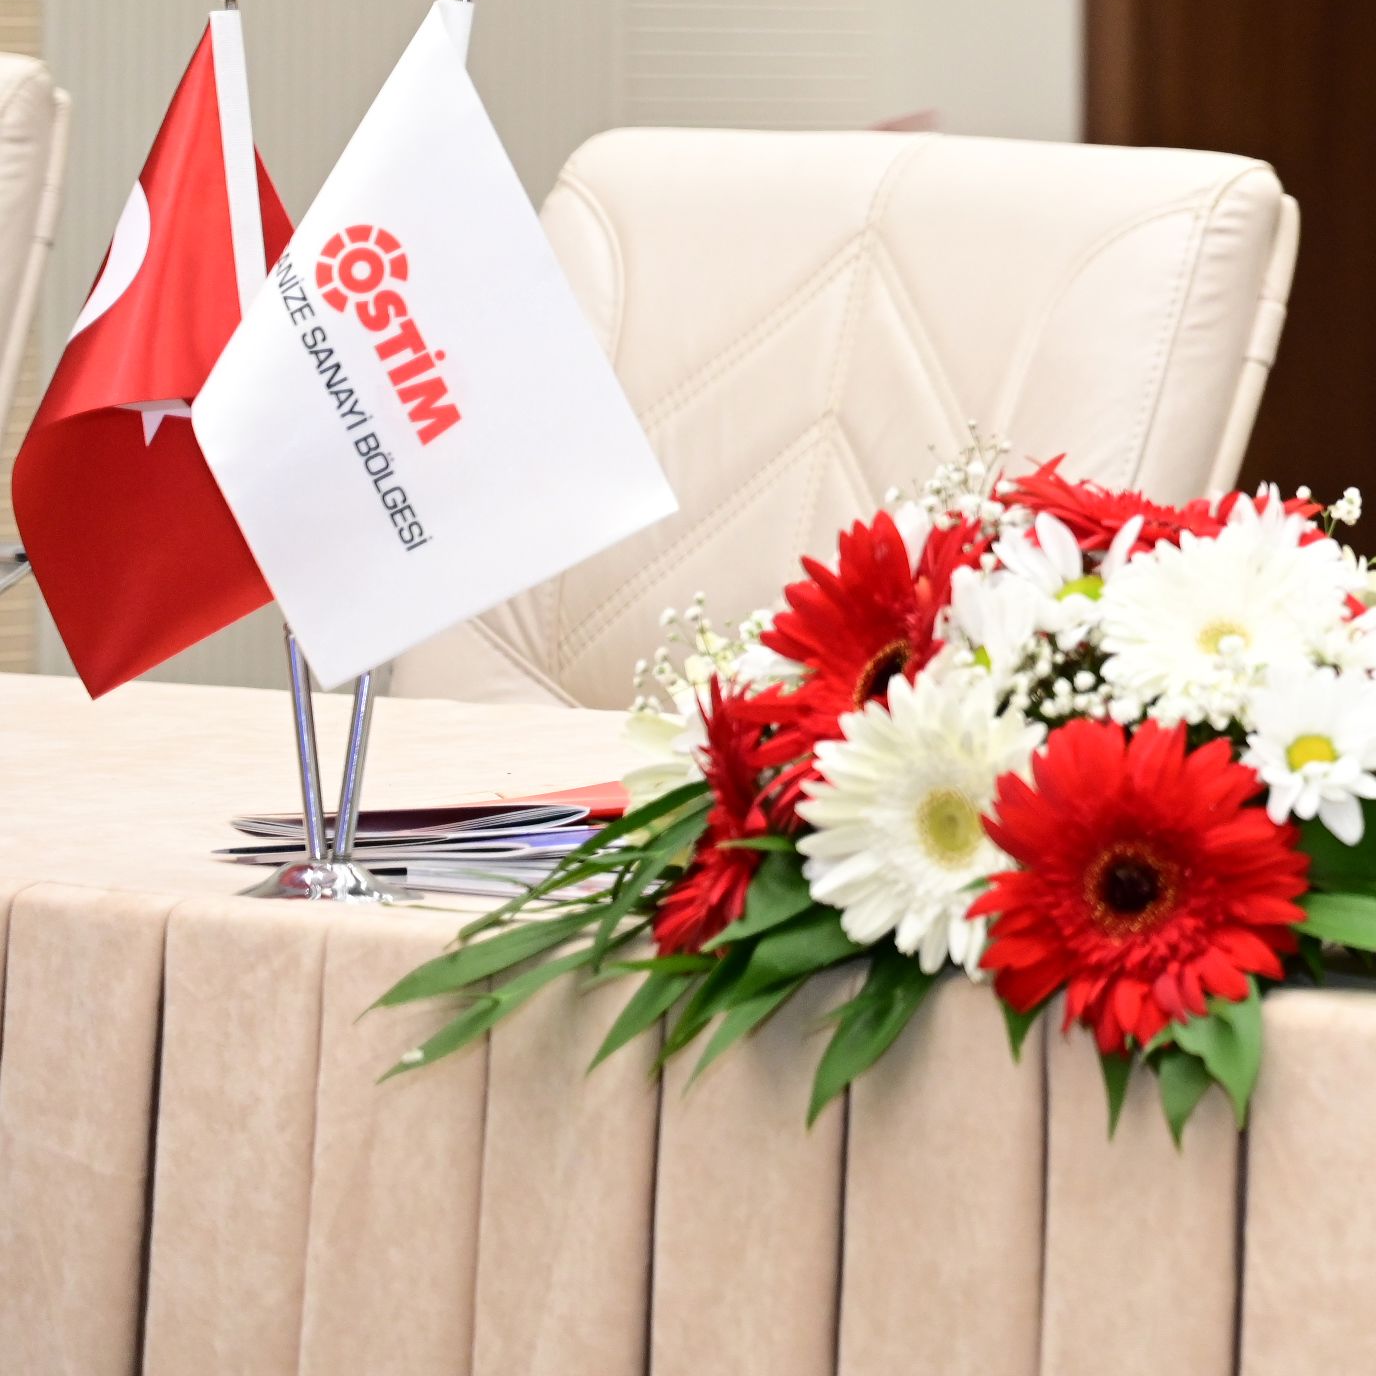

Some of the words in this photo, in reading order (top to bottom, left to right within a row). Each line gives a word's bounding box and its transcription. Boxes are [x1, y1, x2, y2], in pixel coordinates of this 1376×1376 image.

[301, 326, 373, 432] SANAYİ
[353, 432, 433, 552] BÖLGESİ
[333, 242, 462, 447] OSTİM
